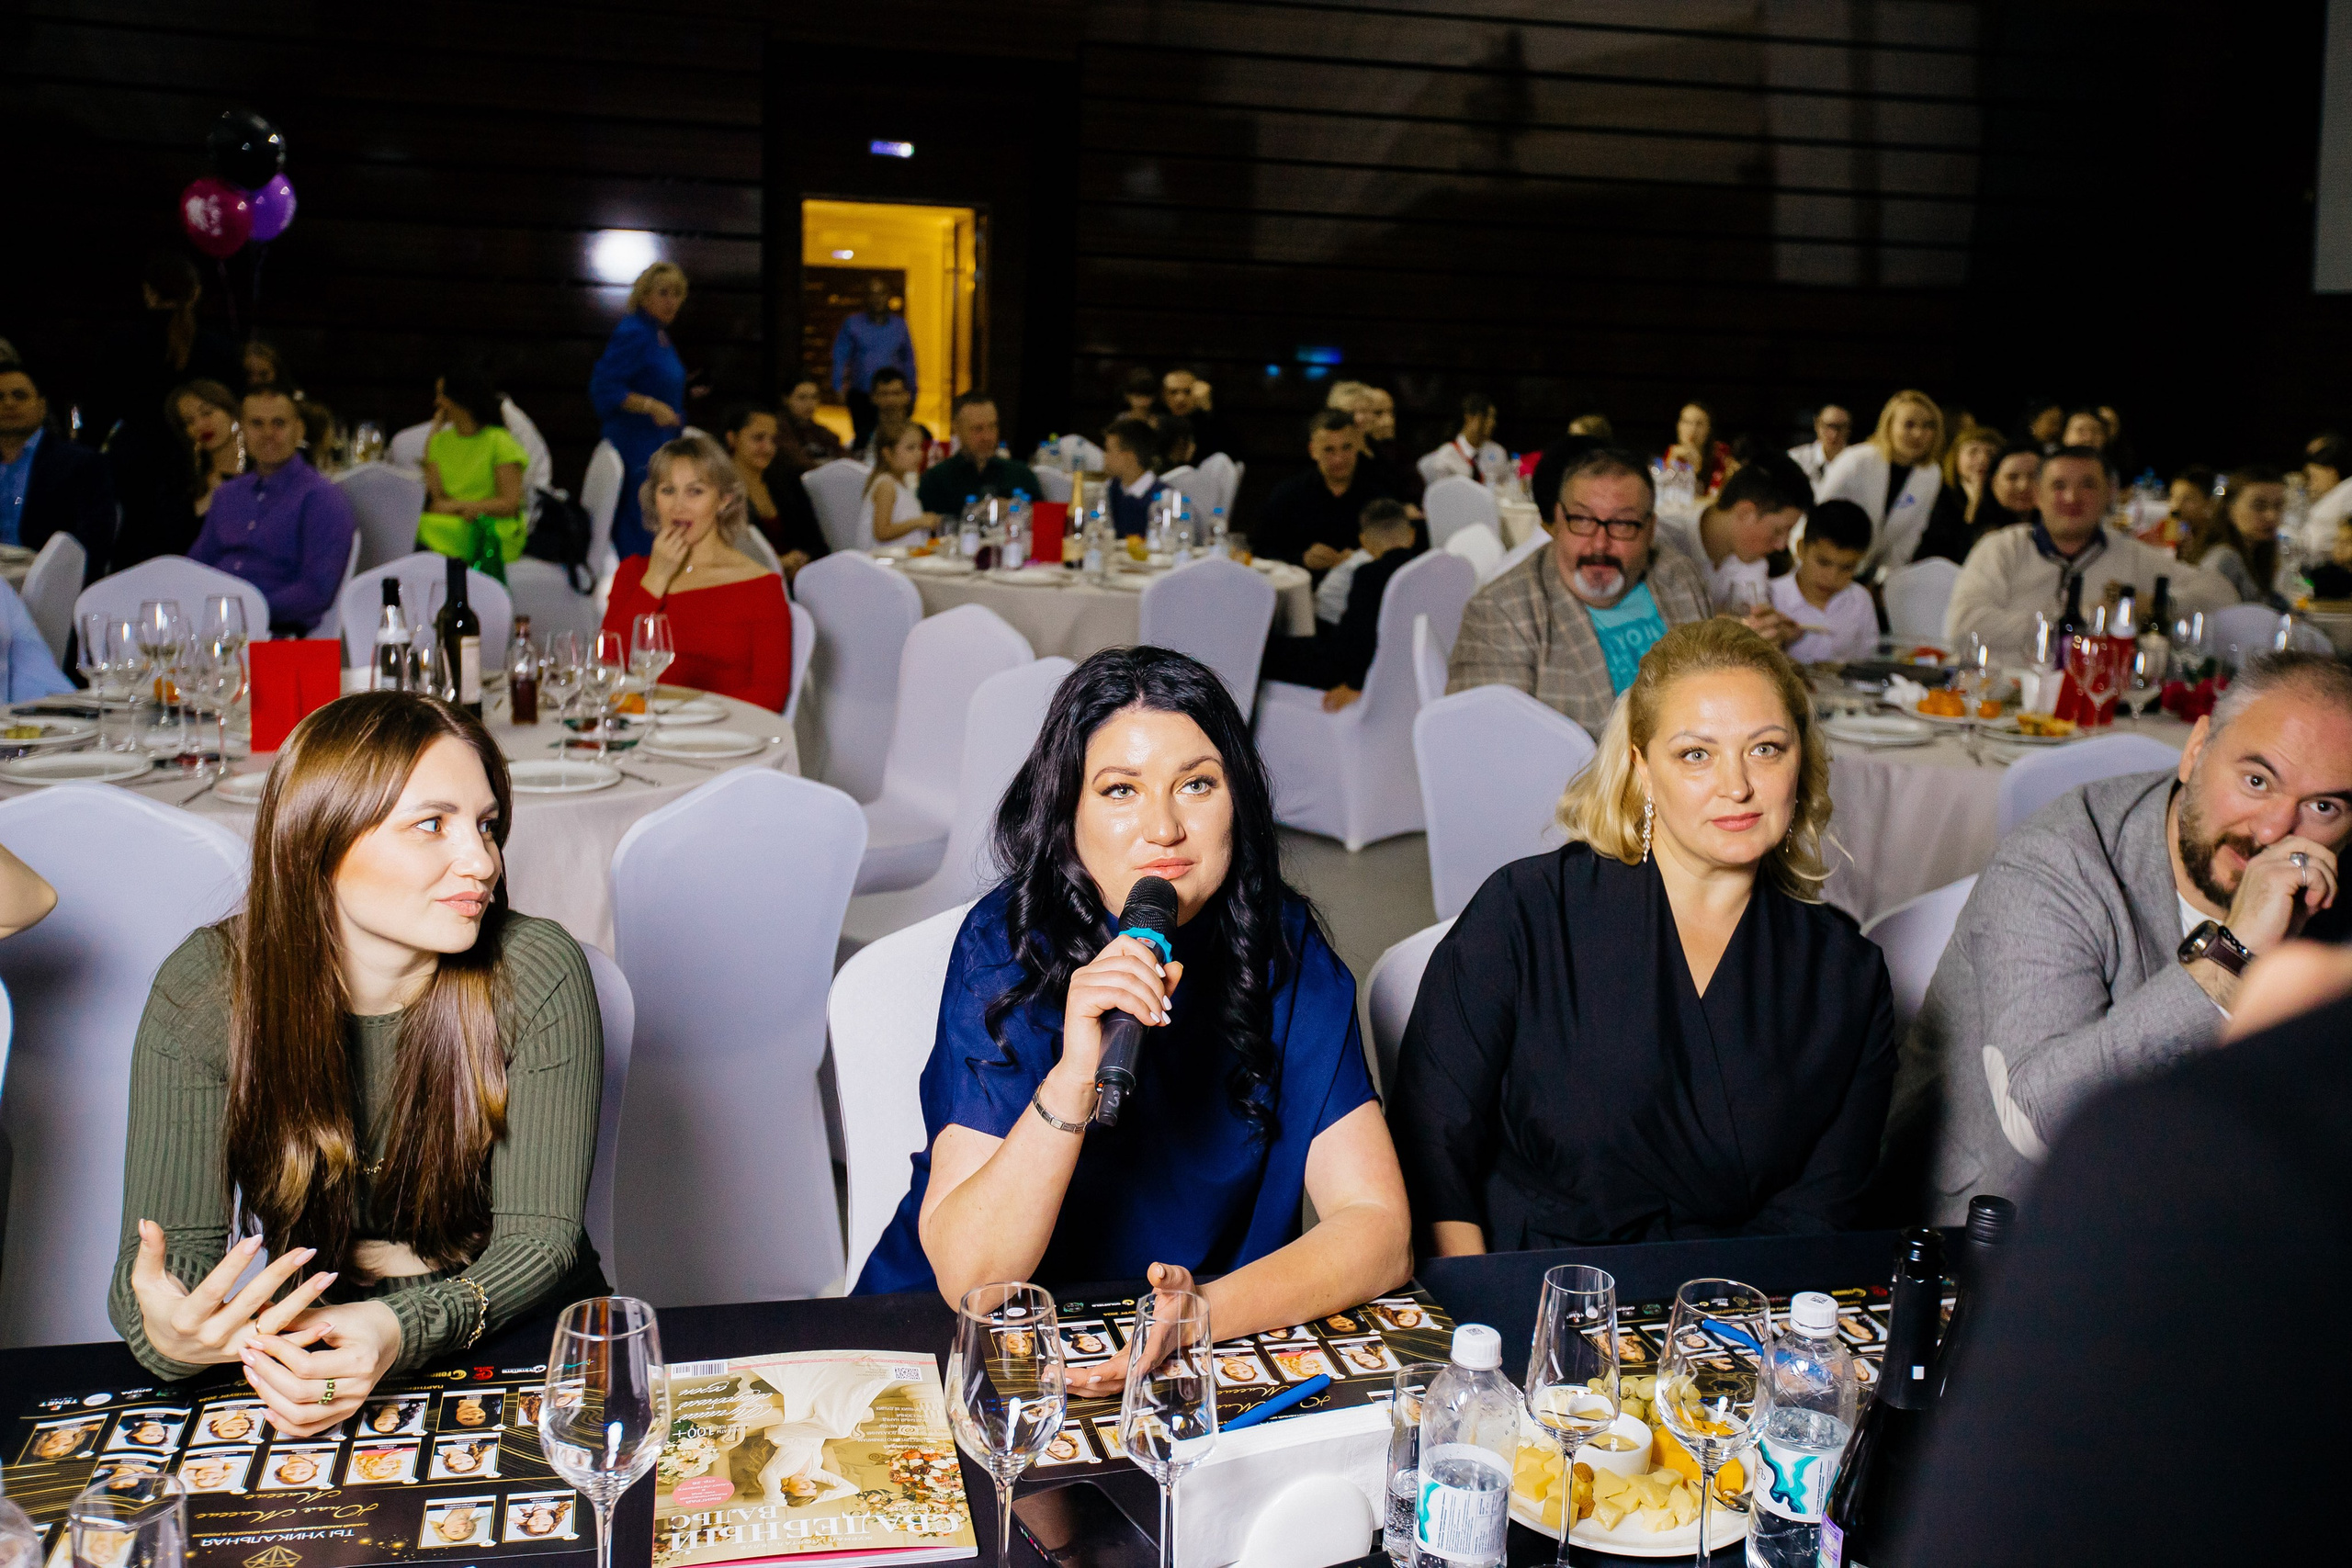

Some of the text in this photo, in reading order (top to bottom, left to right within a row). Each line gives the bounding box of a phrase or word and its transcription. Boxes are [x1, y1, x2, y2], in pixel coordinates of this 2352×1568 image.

[38, 1398, 79, 1407] TENET
[672, 1425, 715, 1439] 100+
[242, 1489, 343, 1505] Миссис
[194, 1502, 379, 1524] Юная Миссис
[671, 1506, 778, 1530] ВАЛЬС
[199, 1528, 355, 1547] ТЫ УНИКАЛЬНАЯ
[669, 1511, 958, 1555] СВАДЕБНЫЙ
